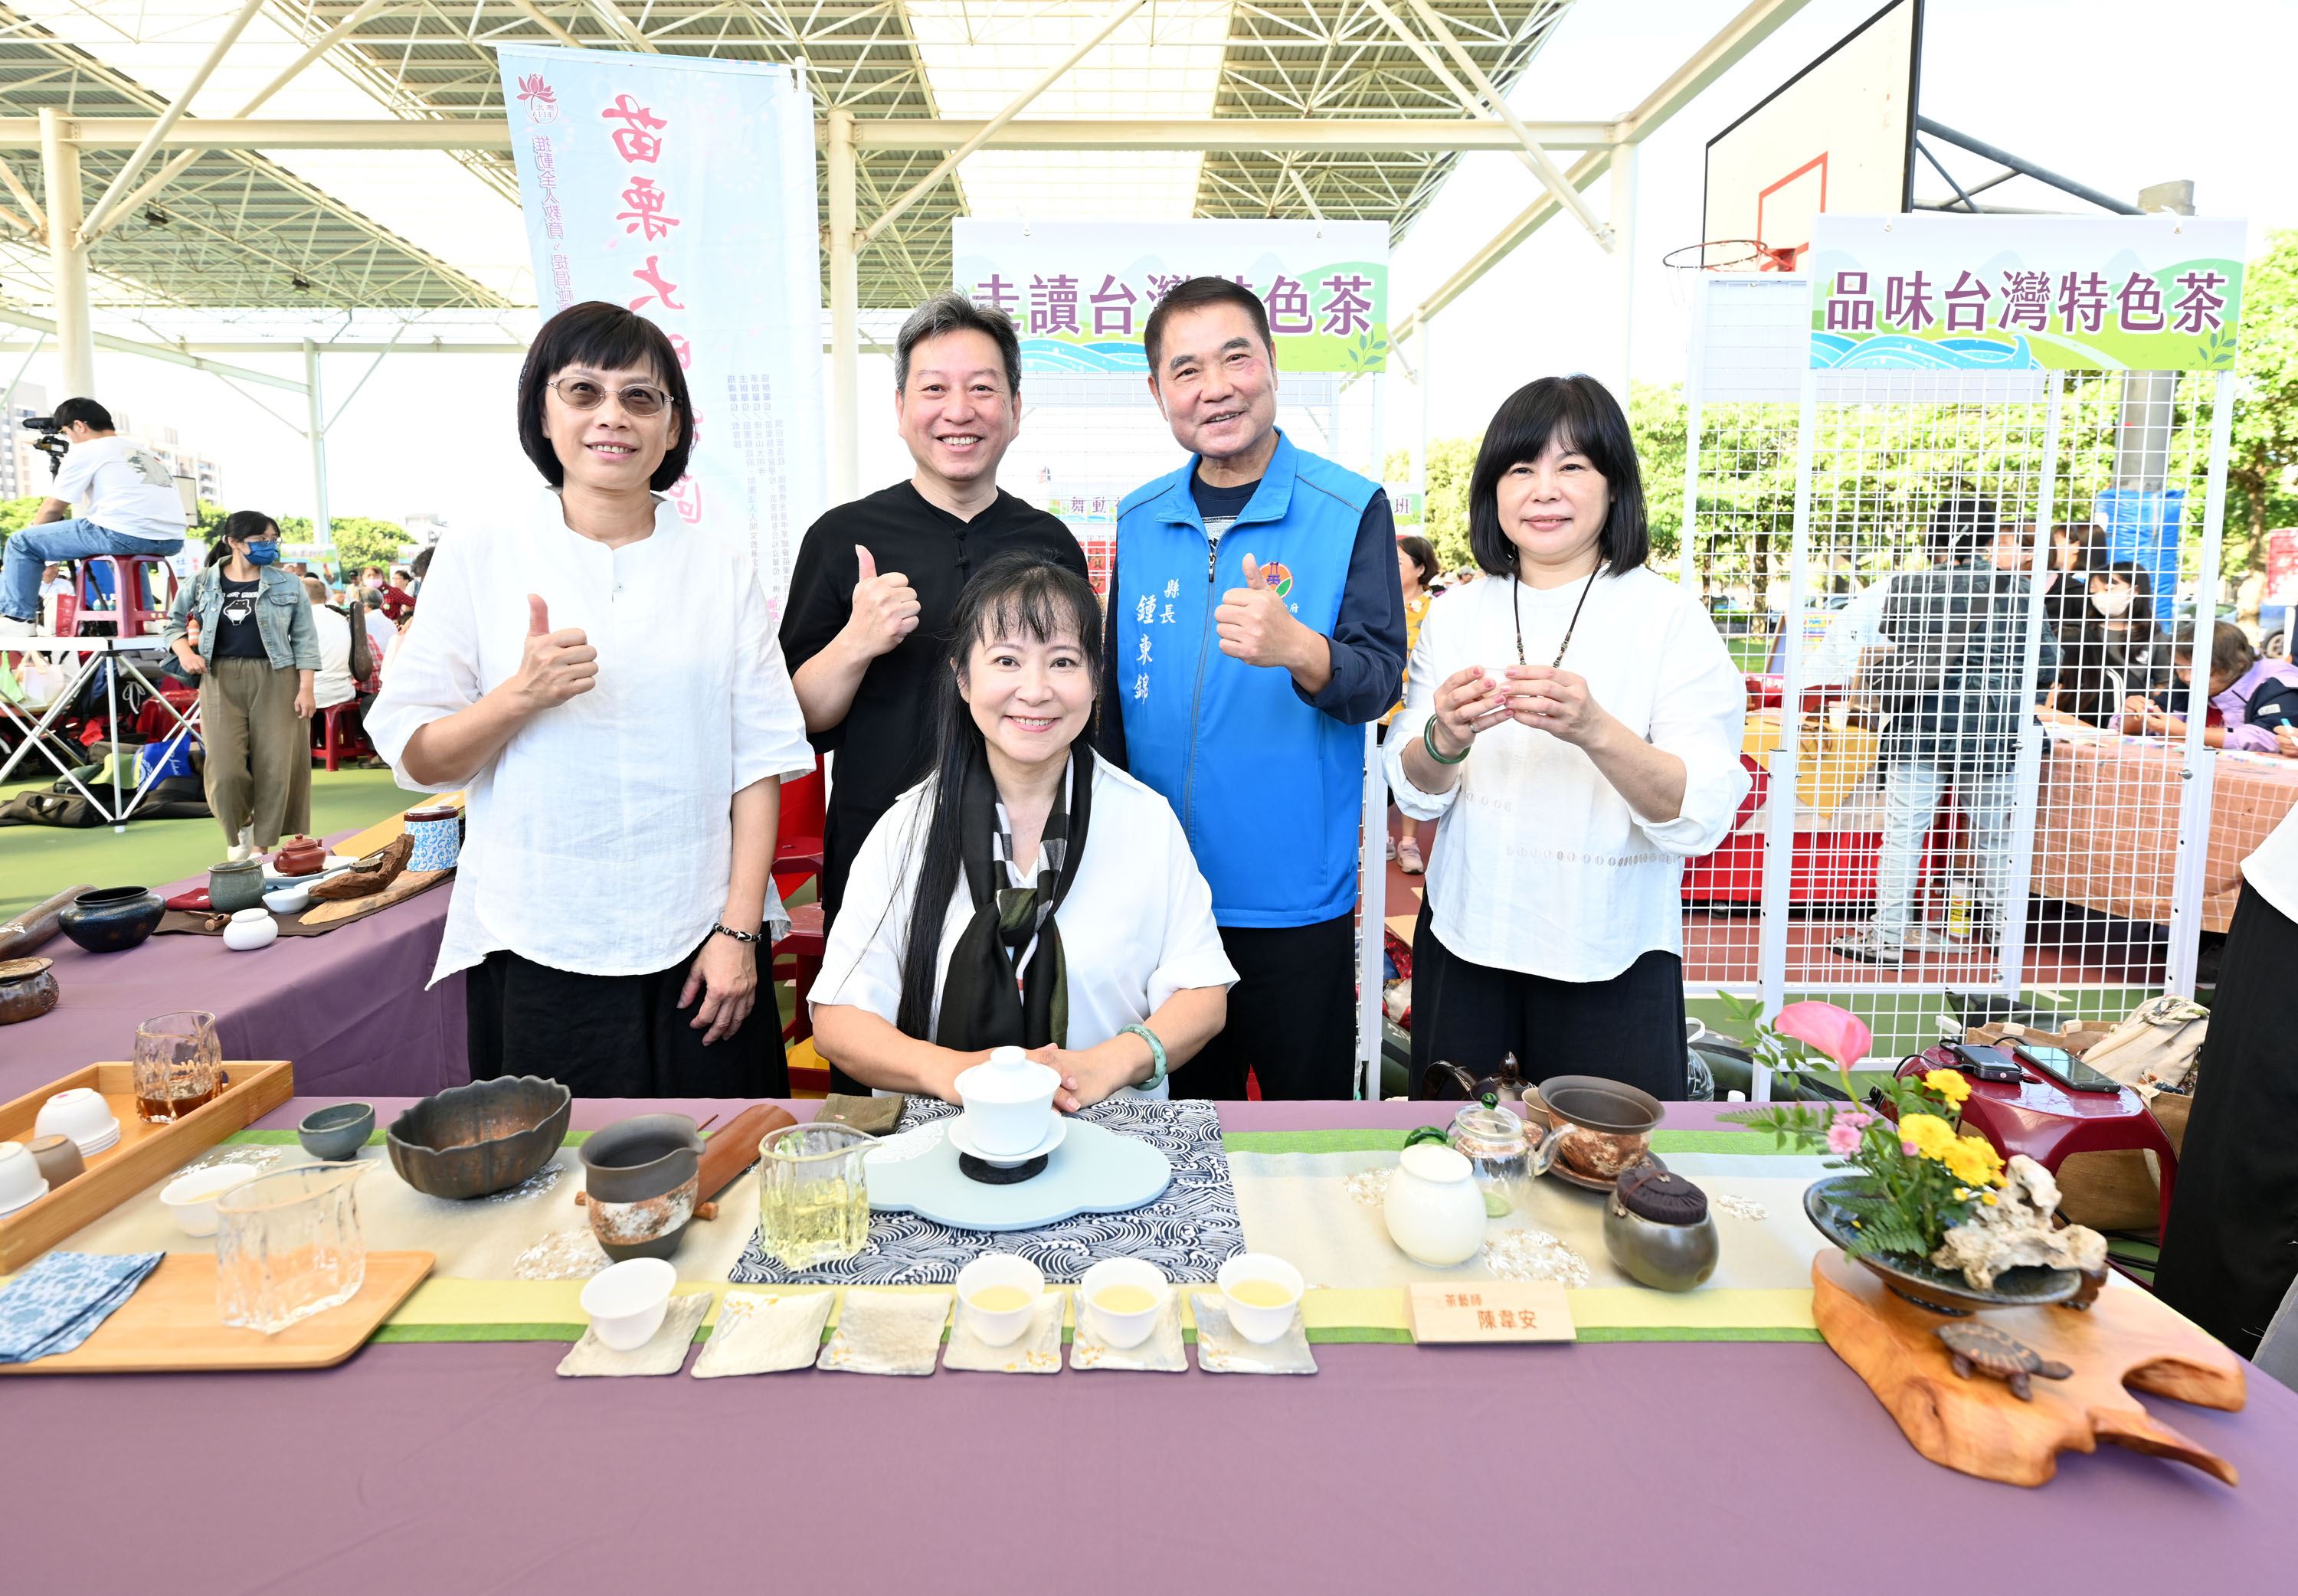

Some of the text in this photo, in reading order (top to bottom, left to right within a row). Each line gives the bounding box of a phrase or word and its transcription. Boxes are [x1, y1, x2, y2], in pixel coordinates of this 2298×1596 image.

[972, 273, 1373, 335] 走讀台色茶
[1826, 270, 2227, 333] 品味台灣特色茶
[1160, 578, 1180, 624] 縣長
